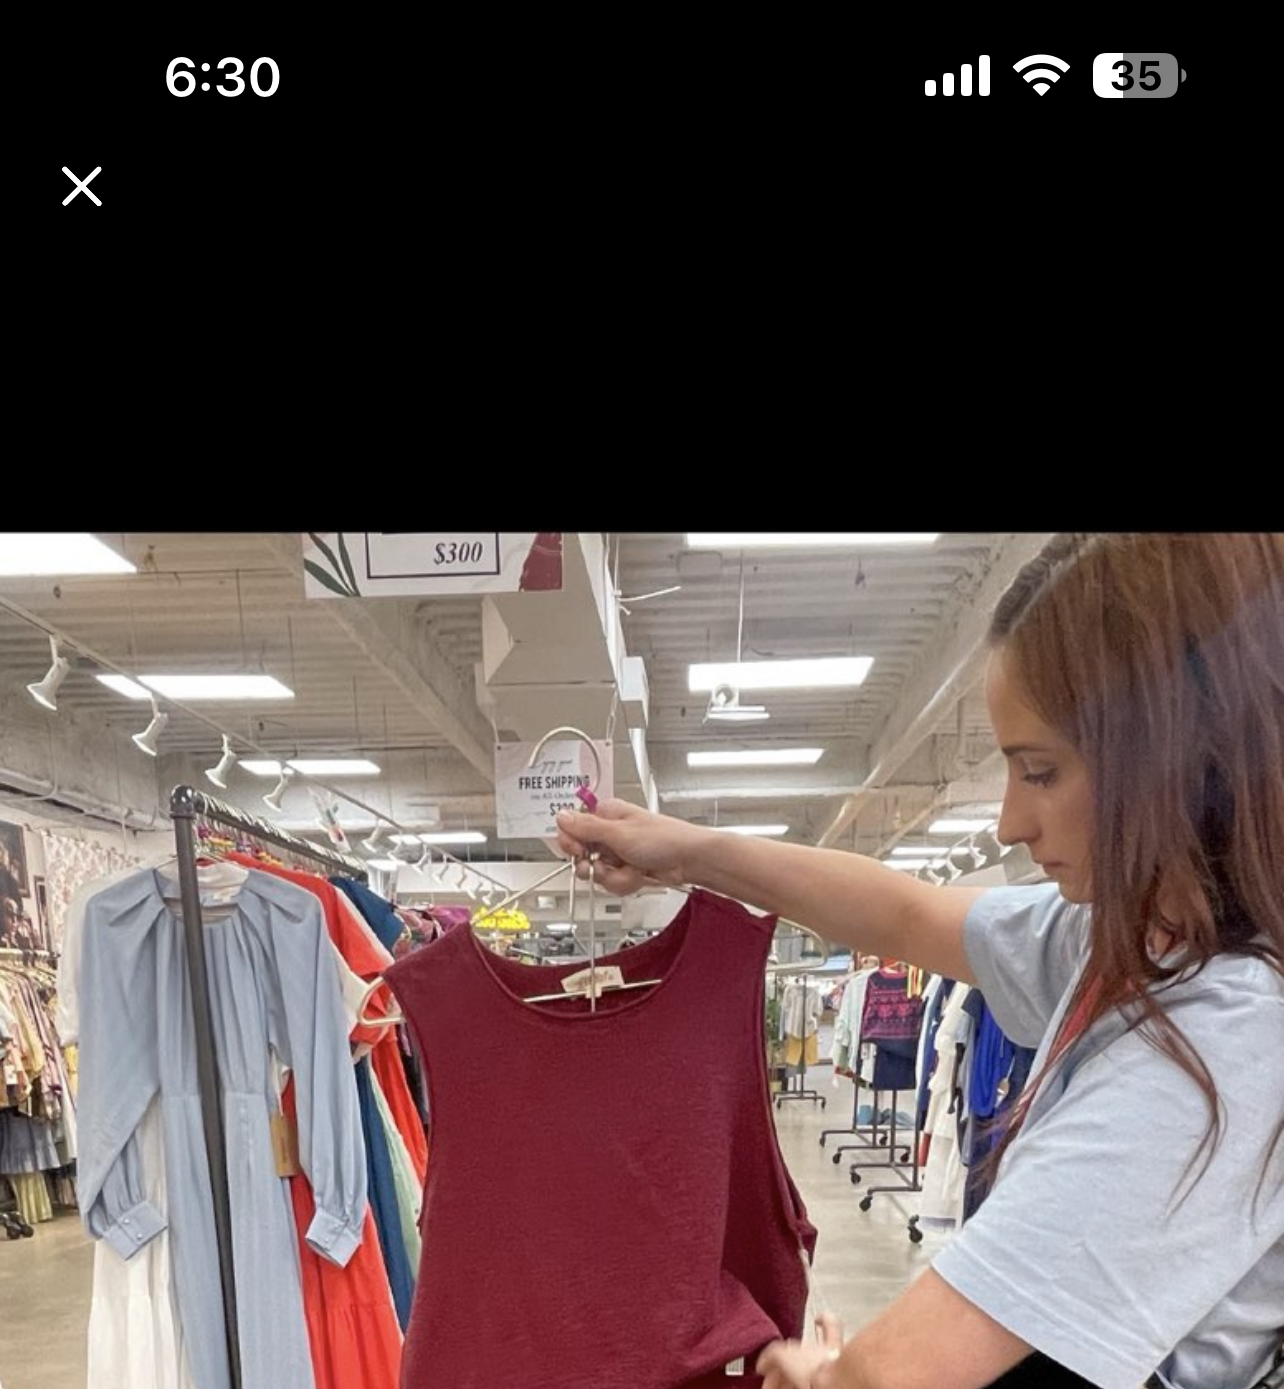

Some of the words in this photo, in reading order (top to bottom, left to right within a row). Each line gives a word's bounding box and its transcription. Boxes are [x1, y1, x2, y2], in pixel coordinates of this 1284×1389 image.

[434, 542, 483, 565] $300
[519, 776, 543, 790] FREE
[545, 775, 590, 789] SHIPPING
